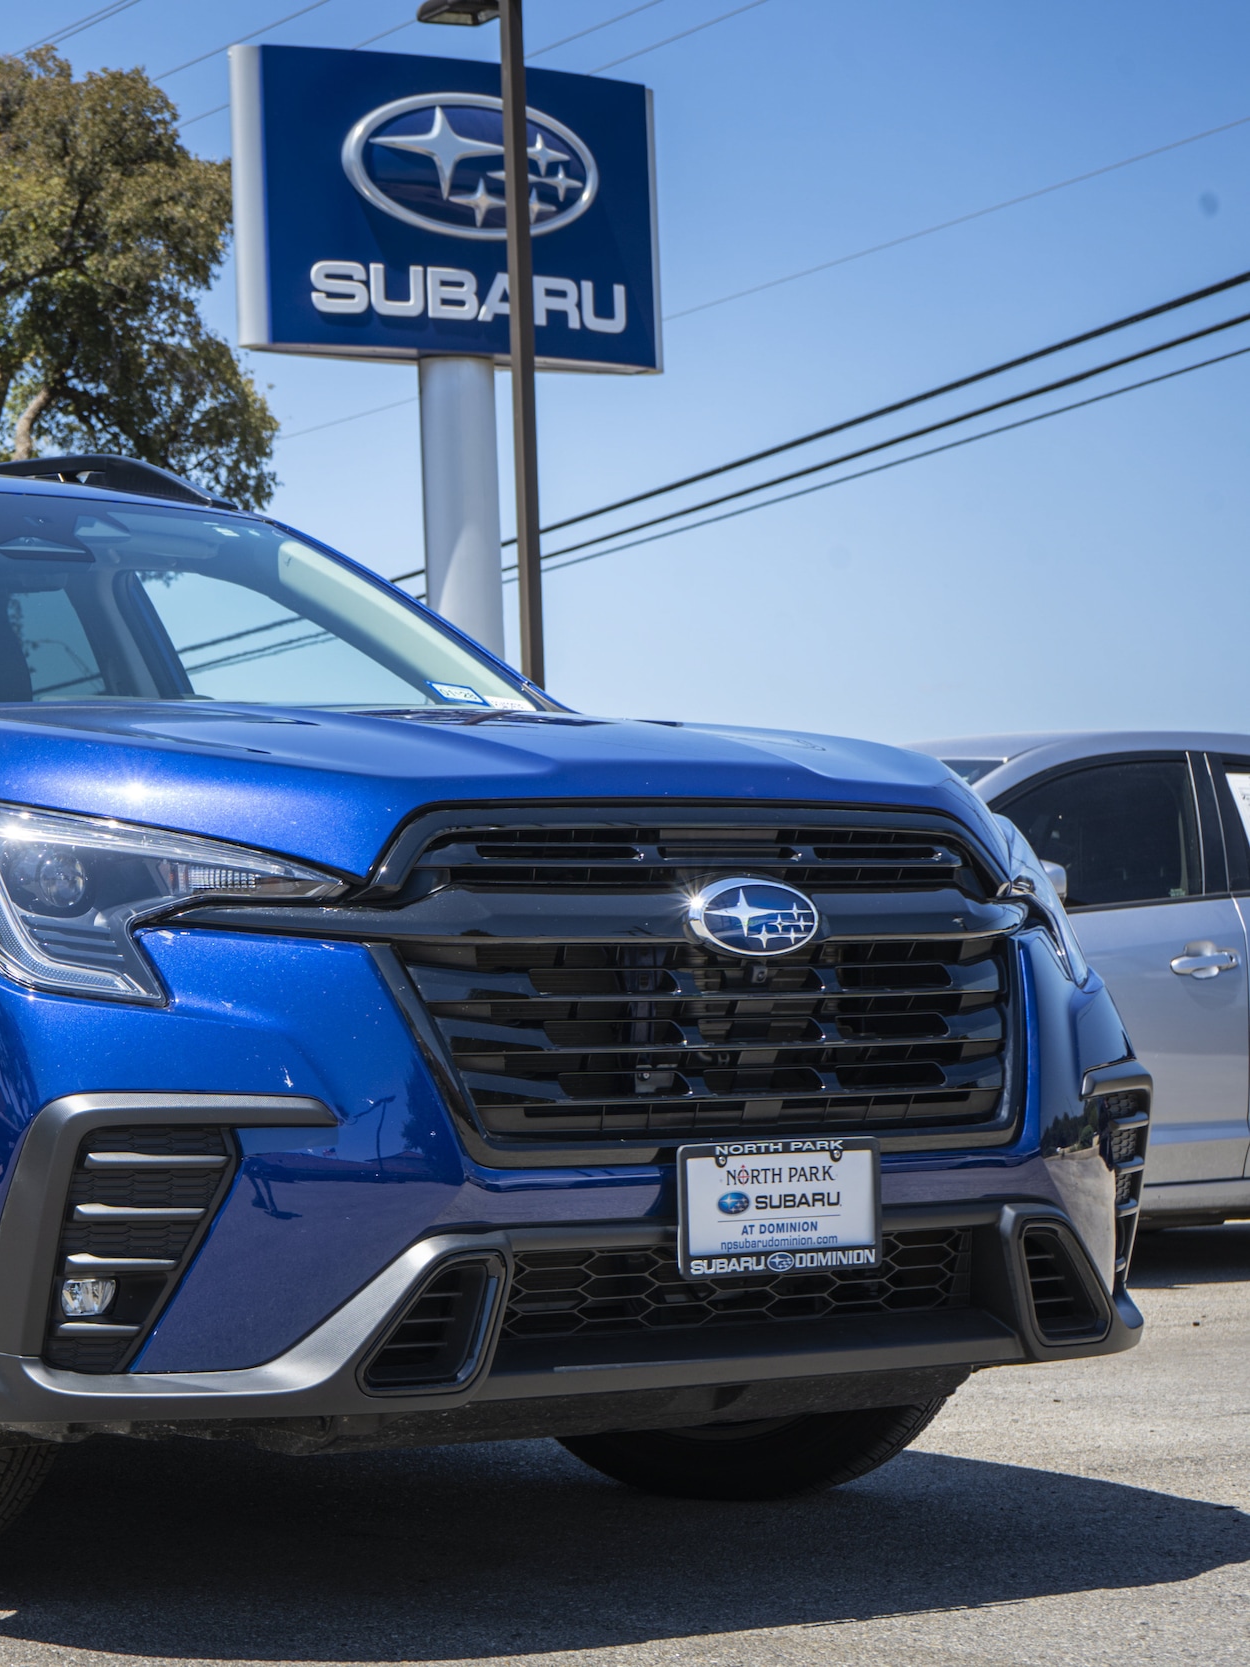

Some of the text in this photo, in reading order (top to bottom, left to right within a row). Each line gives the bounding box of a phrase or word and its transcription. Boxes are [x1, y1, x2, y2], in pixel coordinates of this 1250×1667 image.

[310, 260, 626, 334] SUBARU
[715, 1140, 844, 1156] NORTH PARK
[725, 1165, 835, 1186] NORTH PARK
[754, 1191, 841, 1211] SUBARU
[741, 1221, 818, 1236] AT DOMINION
[720, 1235, 838, 1252] npsubarudominion.com
[690, 1249, 876, 1275] SUBARU DOMINION
